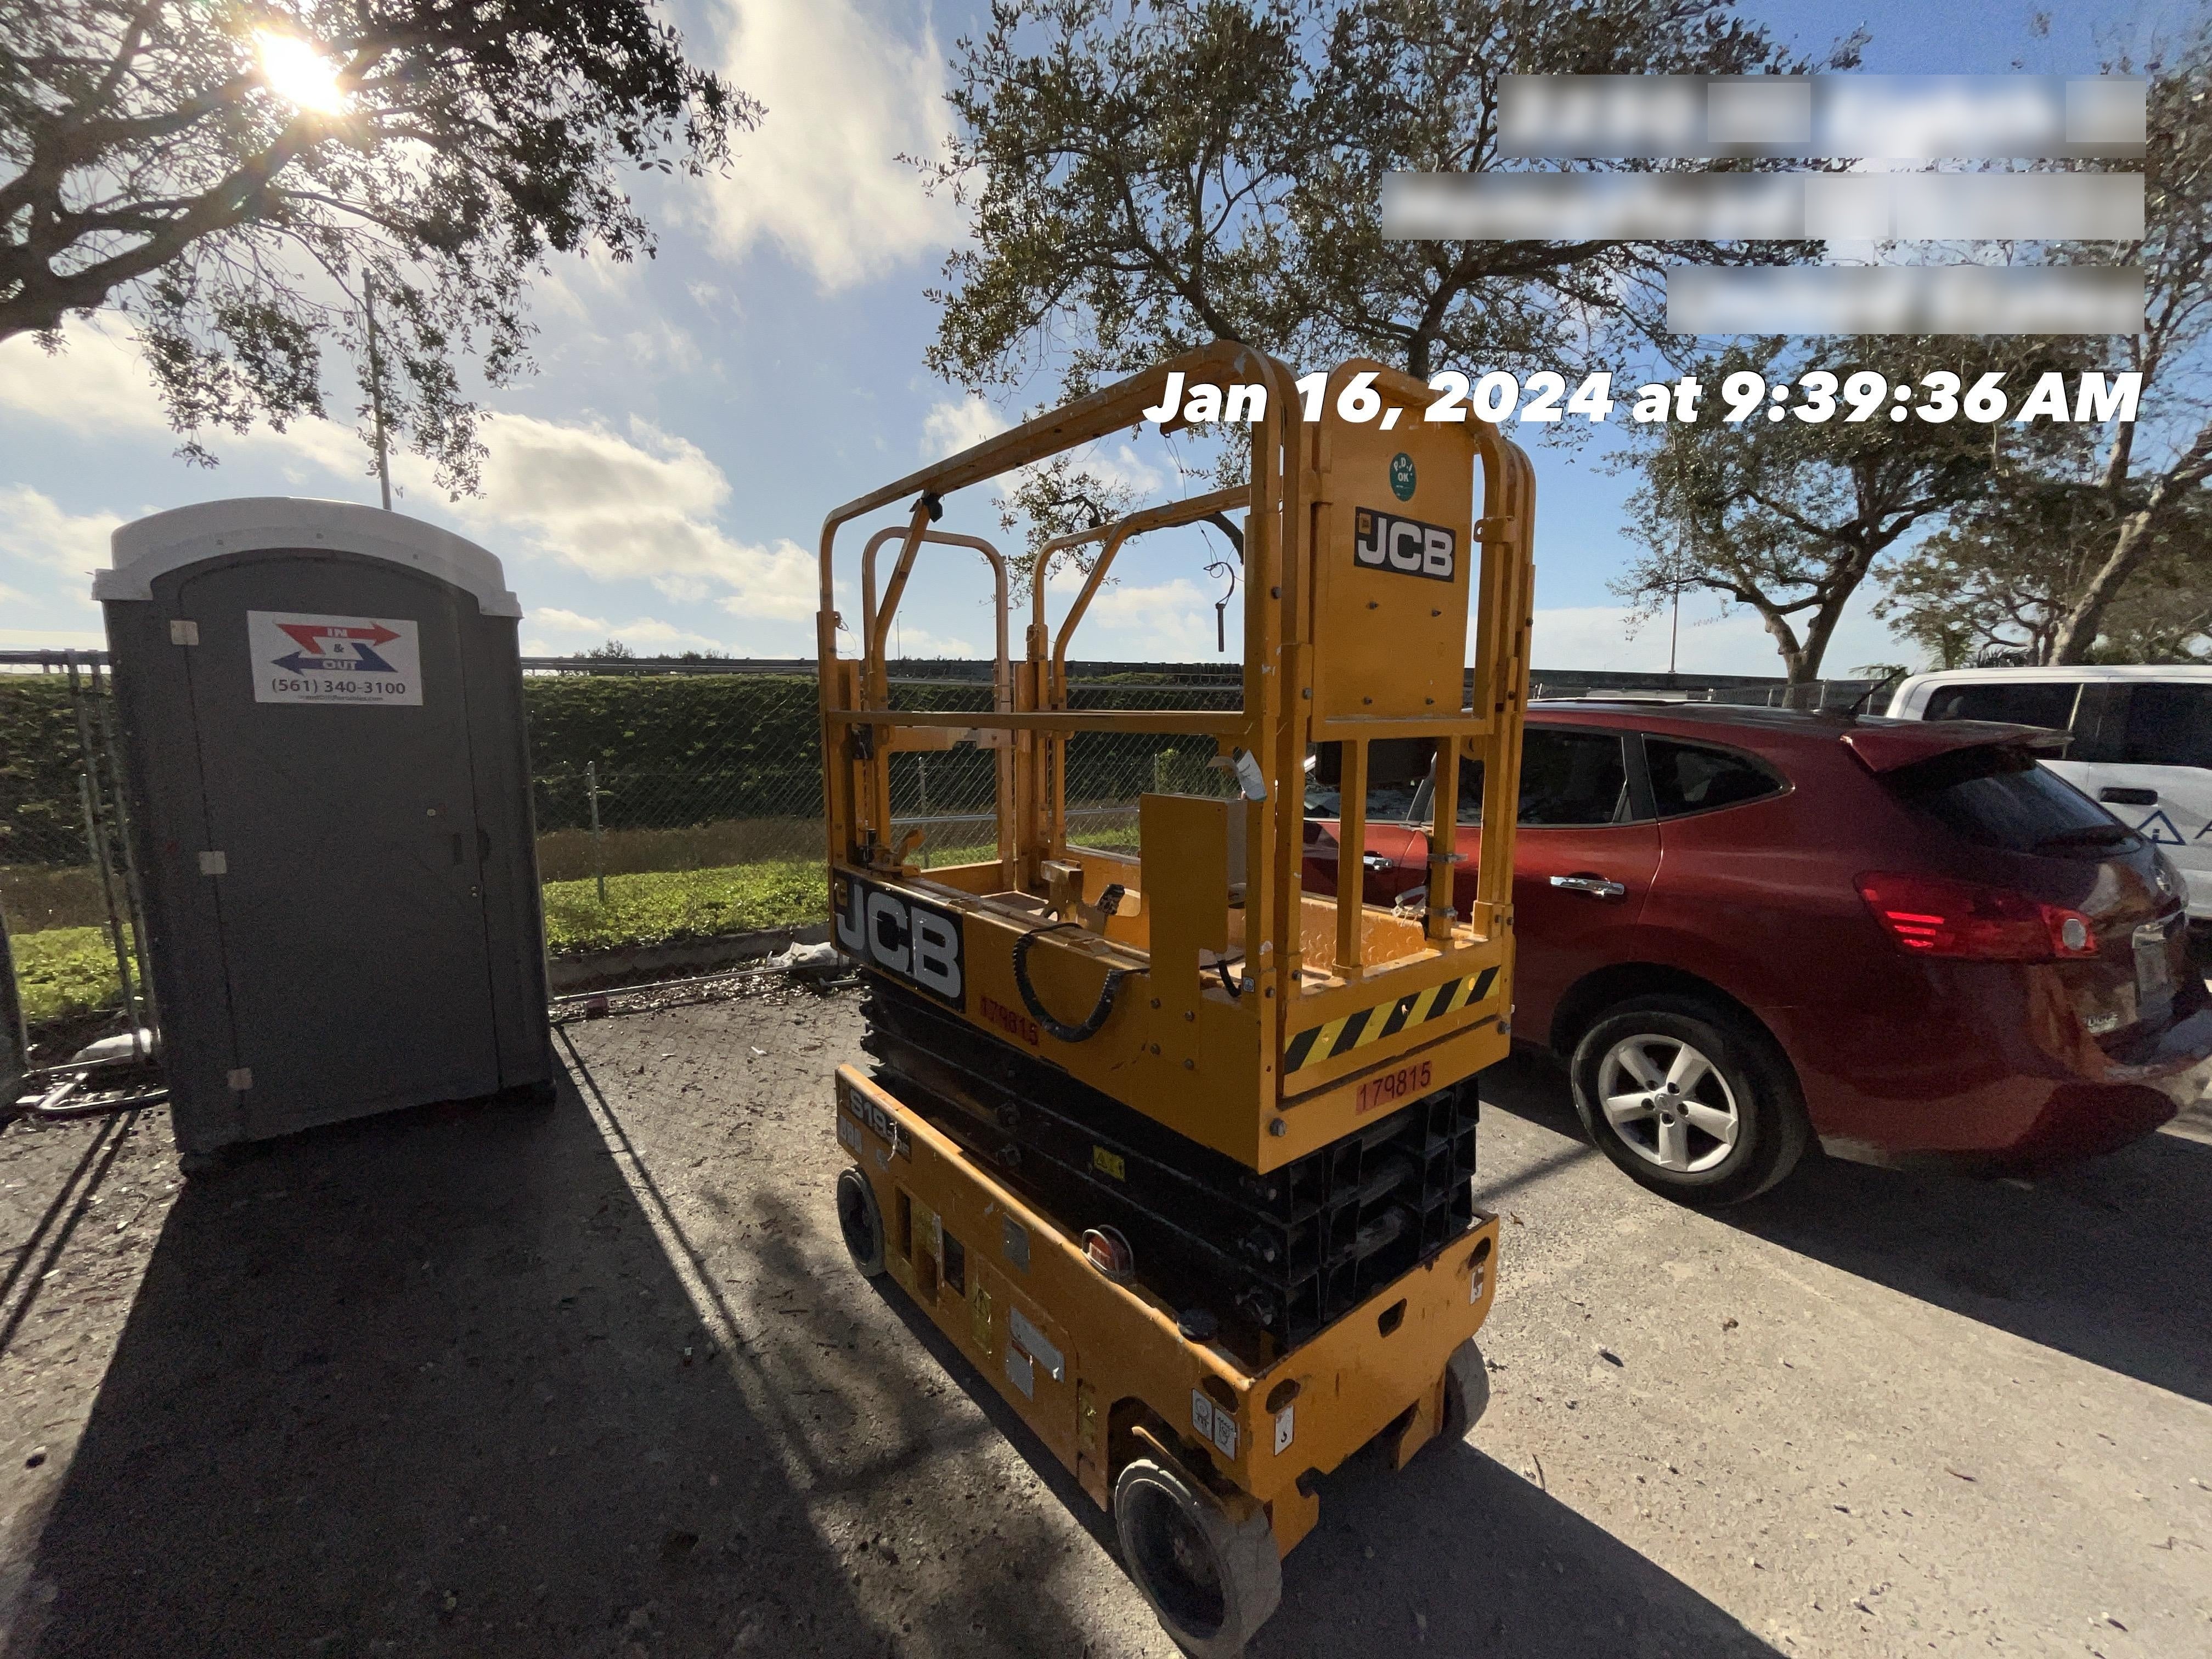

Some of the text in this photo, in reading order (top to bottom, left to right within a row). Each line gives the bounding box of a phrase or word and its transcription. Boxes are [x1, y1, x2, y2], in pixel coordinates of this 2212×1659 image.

[1398, 472, 1409, 482] OK
[1358, 516, 1453, 577] JCB
[327, 628, 348, 637] IN
[334, 644, 345, 653] &
[323, 660, 357, 670] OUT
[272, 679, 406, 695] (561) 340-3100
[837, 882, 961, 998] JCB
[1359, 1060, 1431, 1110] 179815
